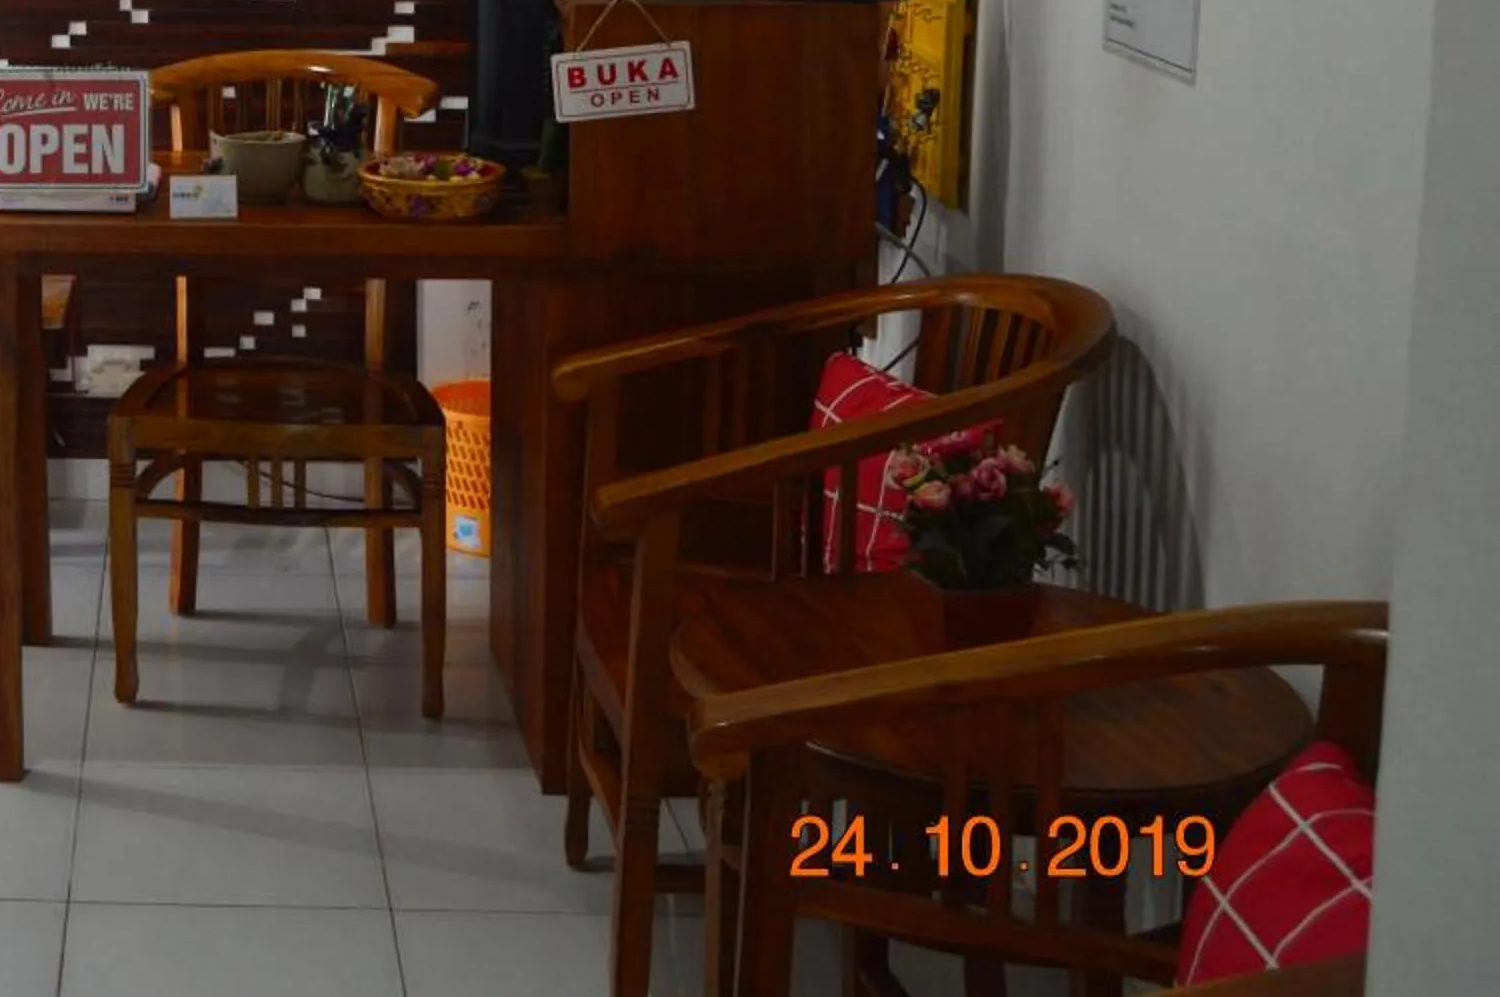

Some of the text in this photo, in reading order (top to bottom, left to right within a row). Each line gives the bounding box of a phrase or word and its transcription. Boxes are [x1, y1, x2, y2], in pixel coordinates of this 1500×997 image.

[567, 57, 679, 89] BUKA
[52, 89, 76, 106] in
[83, 91, 134, 111] WE'RE
[591, 87, 660, 108] OPEN
